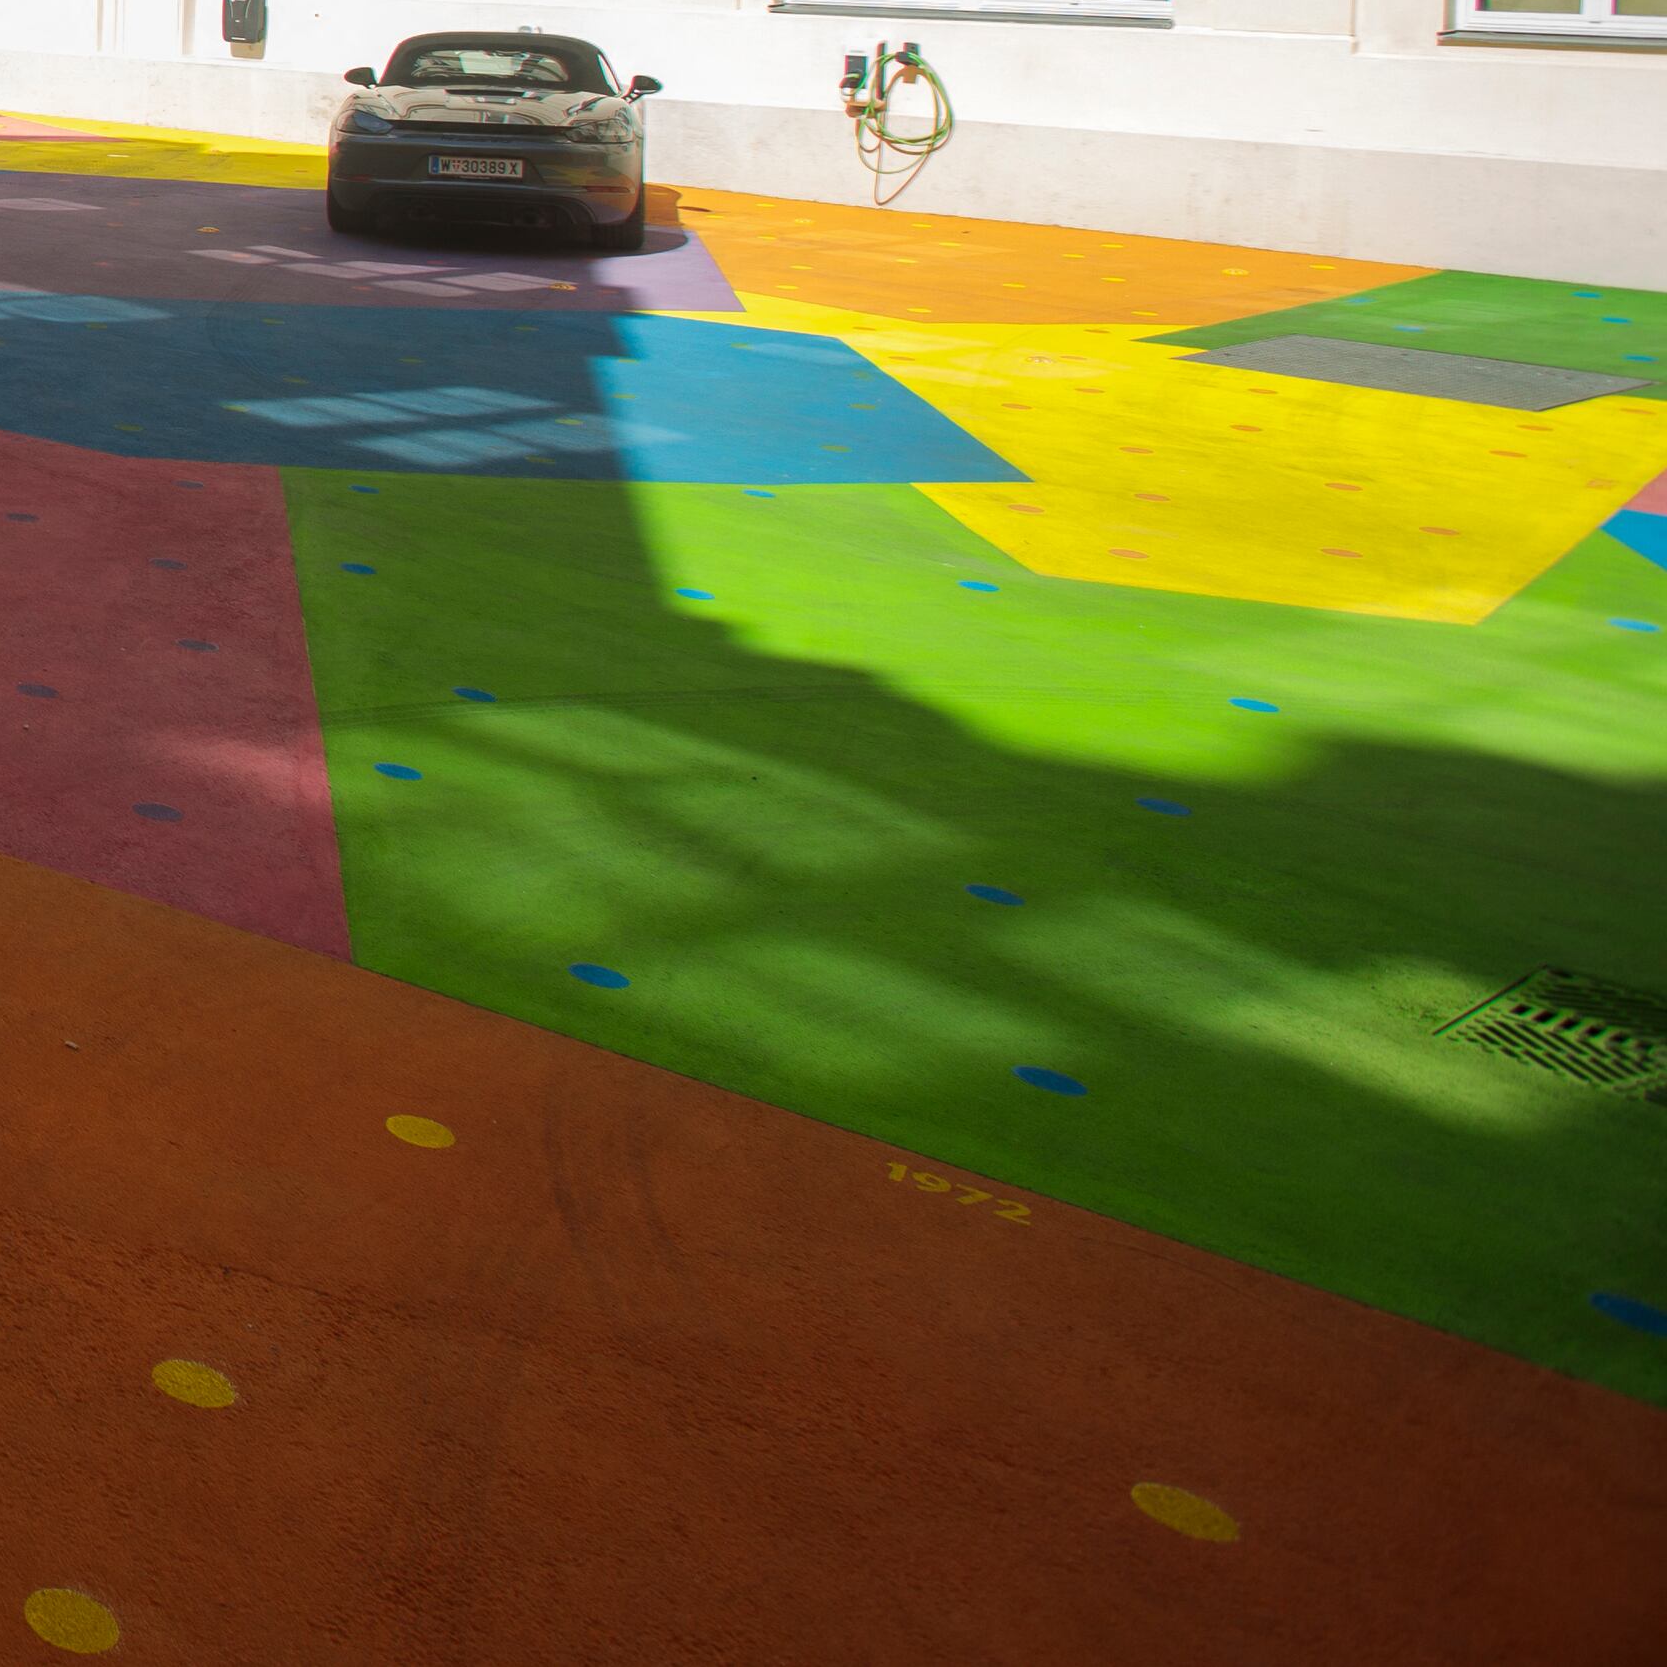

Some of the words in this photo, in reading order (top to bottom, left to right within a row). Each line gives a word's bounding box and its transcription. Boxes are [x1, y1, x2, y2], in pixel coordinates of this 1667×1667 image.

[441, 159, 450, 171] W
[461, 159, 506, 174] 30389
[509, 162, 518, 175] X
[885, 1160, 1033, 1226] 1972
